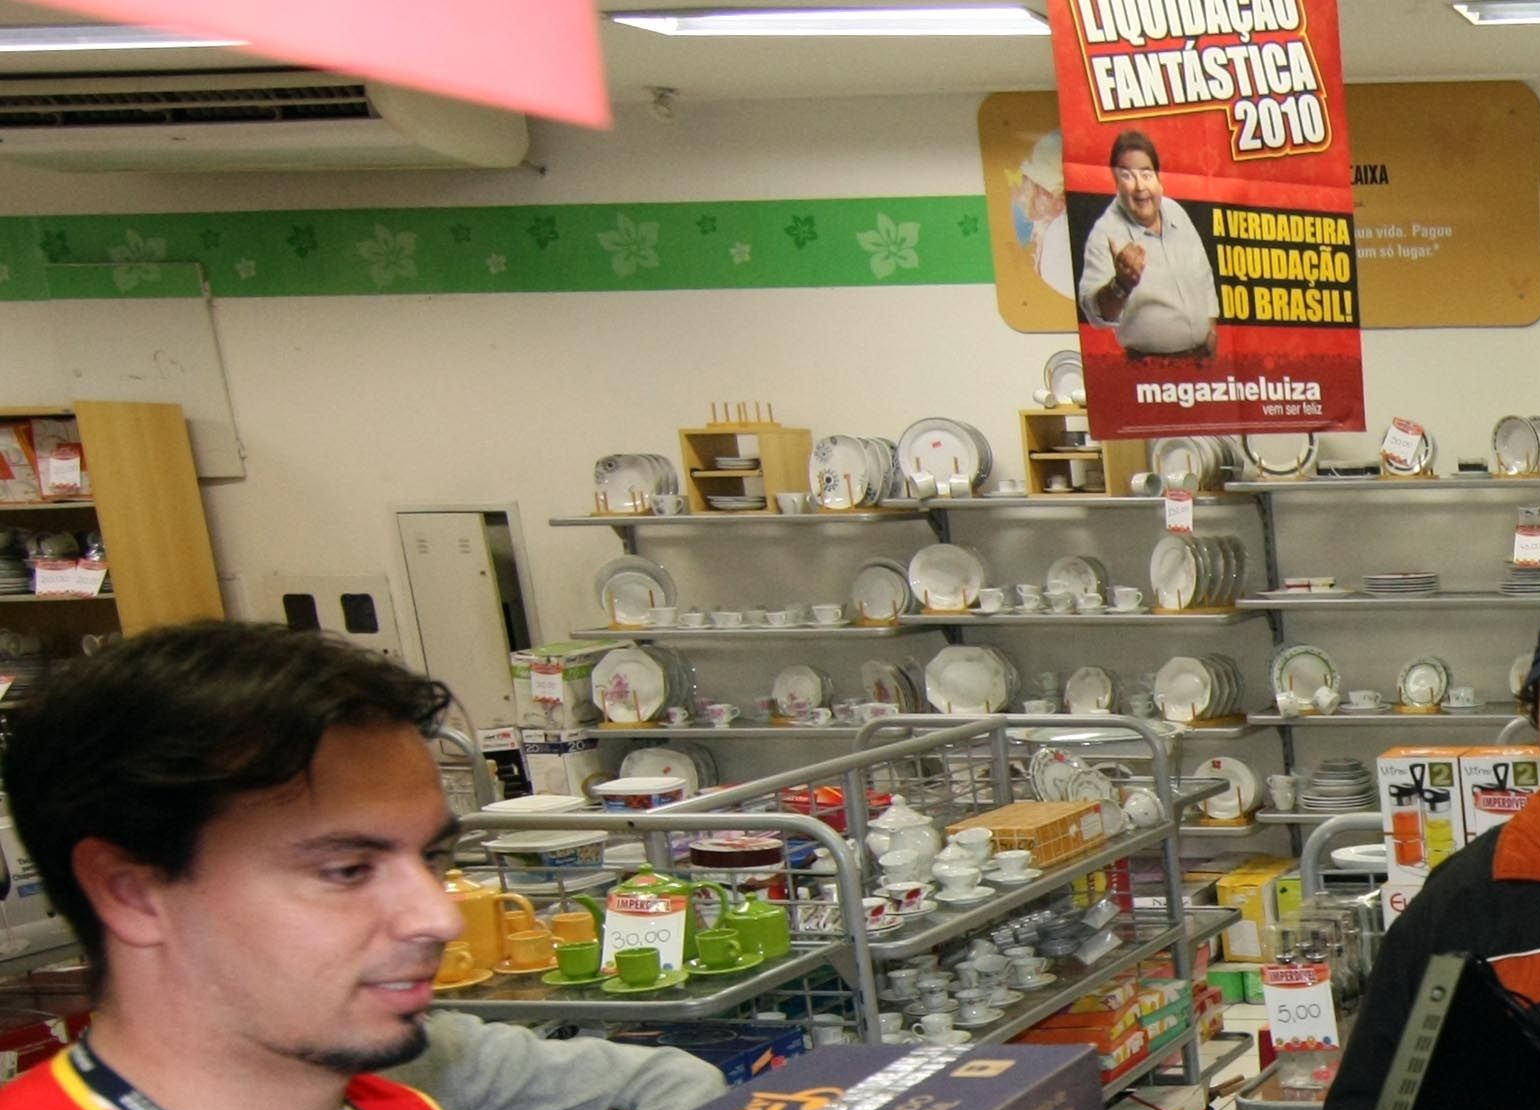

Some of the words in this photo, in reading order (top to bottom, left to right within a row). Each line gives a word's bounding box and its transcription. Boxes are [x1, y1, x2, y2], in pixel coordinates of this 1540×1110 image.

[1091, 40, 1317, 111] FANTÁSTICA
[1235, 94, 1325, 150] 2010
[1212, 208, 1225, 237] A
[1226, 209, 1351, 246] VERDADEIRA
[1375, 224, 1407, 239] vida.
[1412, 223, 1453, 244] Pague
[1379, 244, 1395, 258] só
[1216, 245, 1351, 287] LIQUIDAÇÃO
[1221, 285, 1249, 320] DO
[1253, 286, 1353, 323] BRASIL!
[1136, 375, 1321, 408] magazineluiza
[1262, 404, 1283, 416] vem
[1286, 404, 1301, 415] ser
[1303, 402, 1323, 415] feliz
[1431, 764, 1452, 786] 2
[1515, 763, 1537, 785] 2
[1278, 1003, 1321, 1024] 5,00
